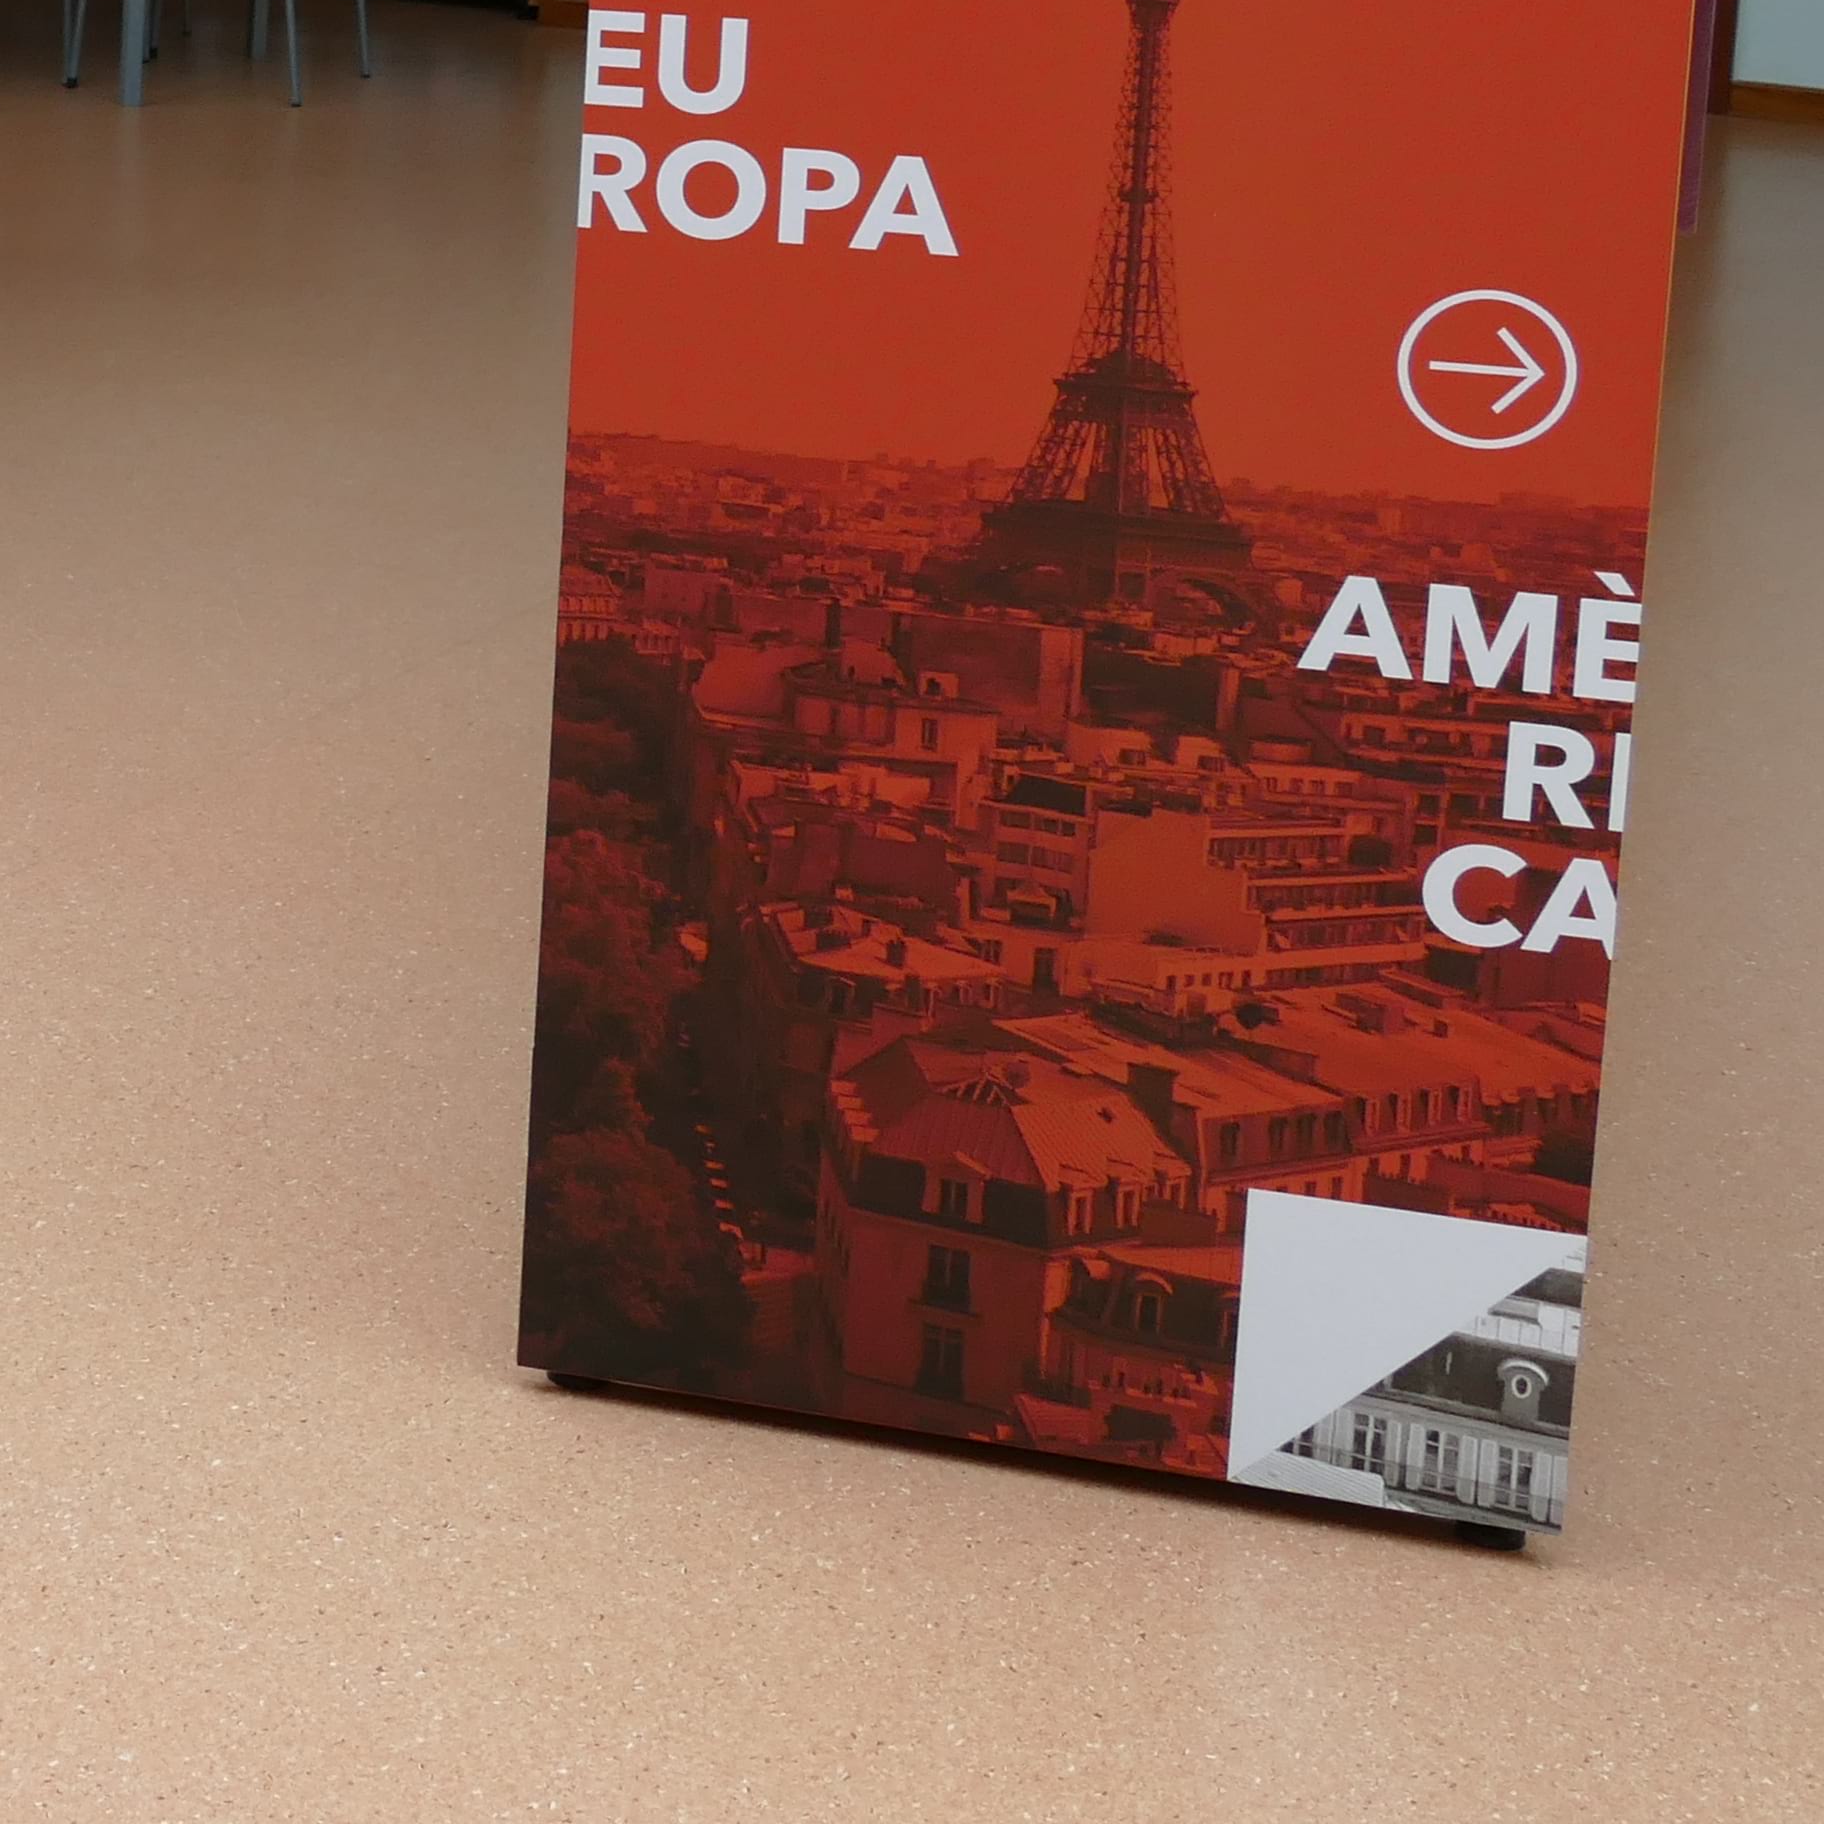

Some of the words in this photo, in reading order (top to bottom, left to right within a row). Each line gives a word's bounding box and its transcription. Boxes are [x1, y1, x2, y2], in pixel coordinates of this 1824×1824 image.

[583, 8, 750, 118] EU
[576, 132, 961, 259] ROPA
[1296, 570, 1643, 704] AMÈ
[1502, 720, 1633, 834] RI
[1421, 842, 1618, 962] CA
